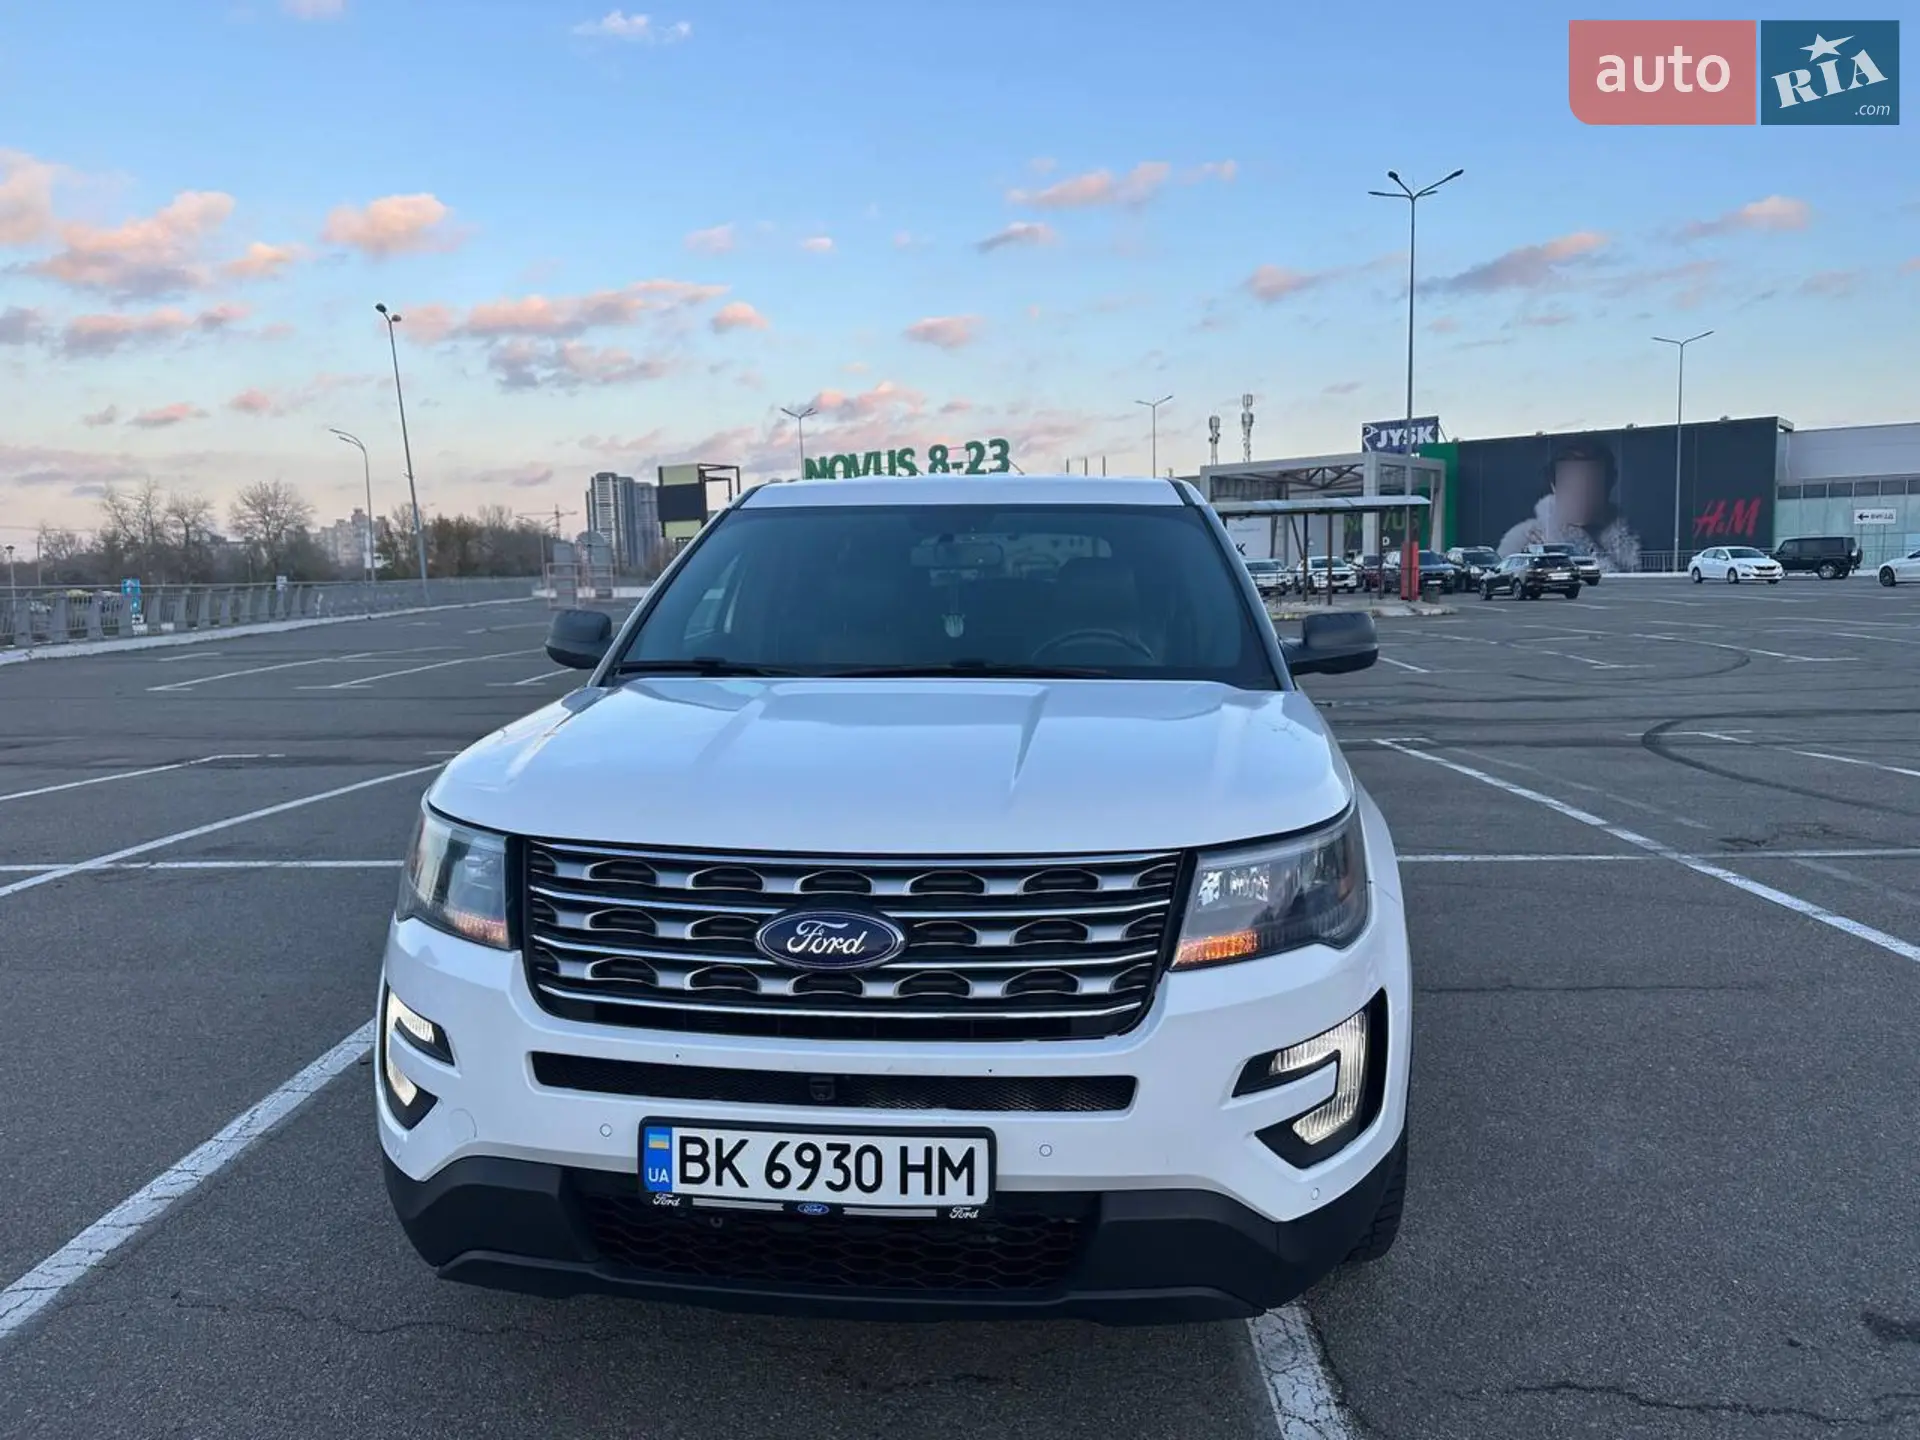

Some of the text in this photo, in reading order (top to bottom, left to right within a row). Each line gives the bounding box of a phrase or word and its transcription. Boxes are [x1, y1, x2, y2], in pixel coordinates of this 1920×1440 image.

[804, 438, 1010, 480] NOVUS 8-23
[786, 919, 868, 955] Ford
[648, 1167, 670, 1184] UA
[678, 1135, 976, 1197] BK 6930 HM
[652, 1193, 681, 1207] Ford
[949, 1206, 979, 1219] Ford
